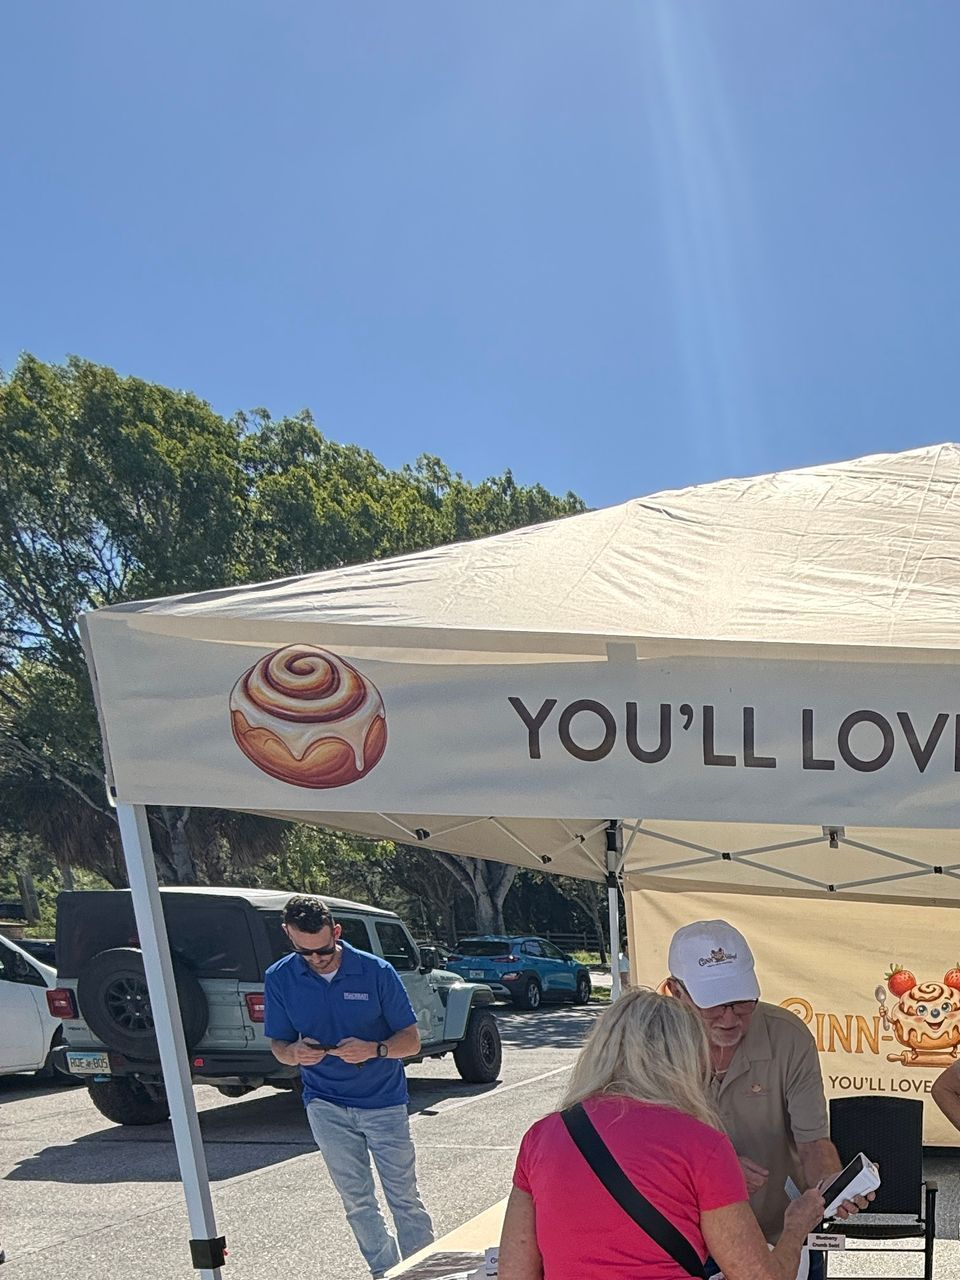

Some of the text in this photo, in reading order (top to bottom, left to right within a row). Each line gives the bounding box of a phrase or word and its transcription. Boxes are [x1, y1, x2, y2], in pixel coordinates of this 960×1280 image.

[507, 696, 777, 769] YOU'LL
[828, 1075, 886, 1092] YOU'LL
[890, 1078, 932, 1094] LOVE
